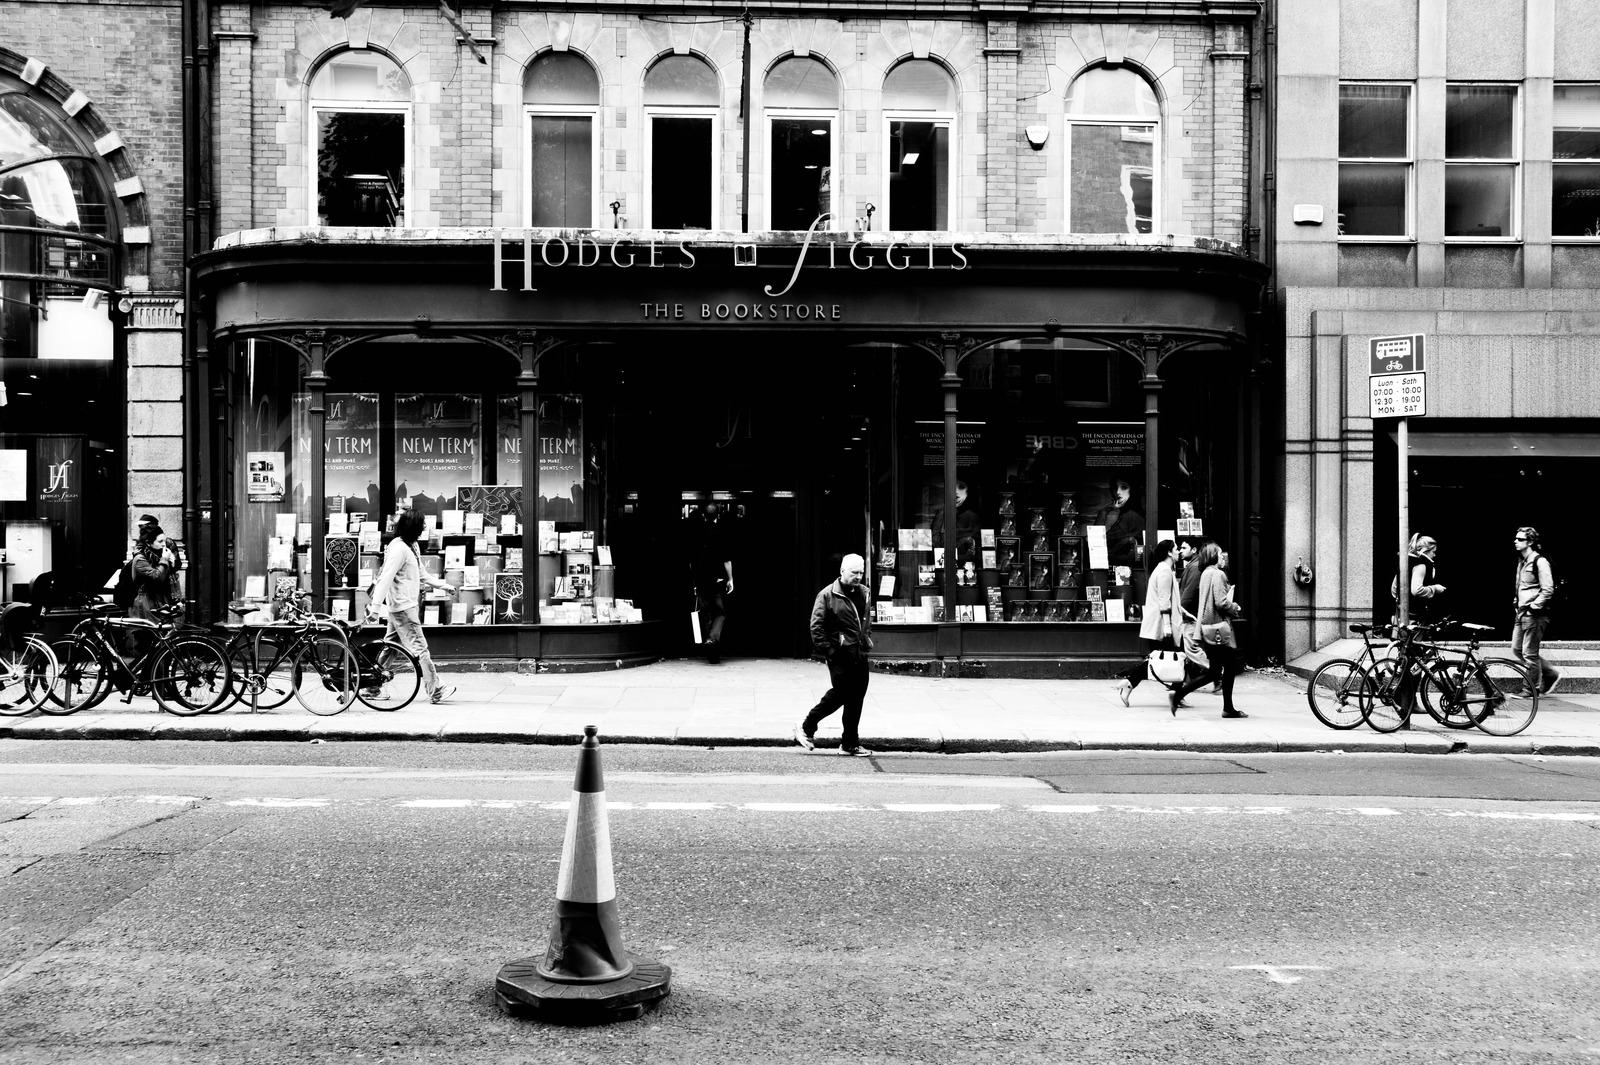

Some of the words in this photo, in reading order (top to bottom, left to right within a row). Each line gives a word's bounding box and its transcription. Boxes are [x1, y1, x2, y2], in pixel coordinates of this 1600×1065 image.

[490, 231, 695, 291] HODGES
[641, 303, 683, 318] THE
[701, 302, 842, 319] BOOKSTORE
[1373, 388, 1393, 396] 07:00
[1378, 406, 1395, 414] MON
[336, 437, 372, 455] TERM
[402, 437, 434, 454] NEW
[438, 437, 475, 455] TERM
[504, 437, 523, 454] NE
[540, 437, 576, 455] TERM
